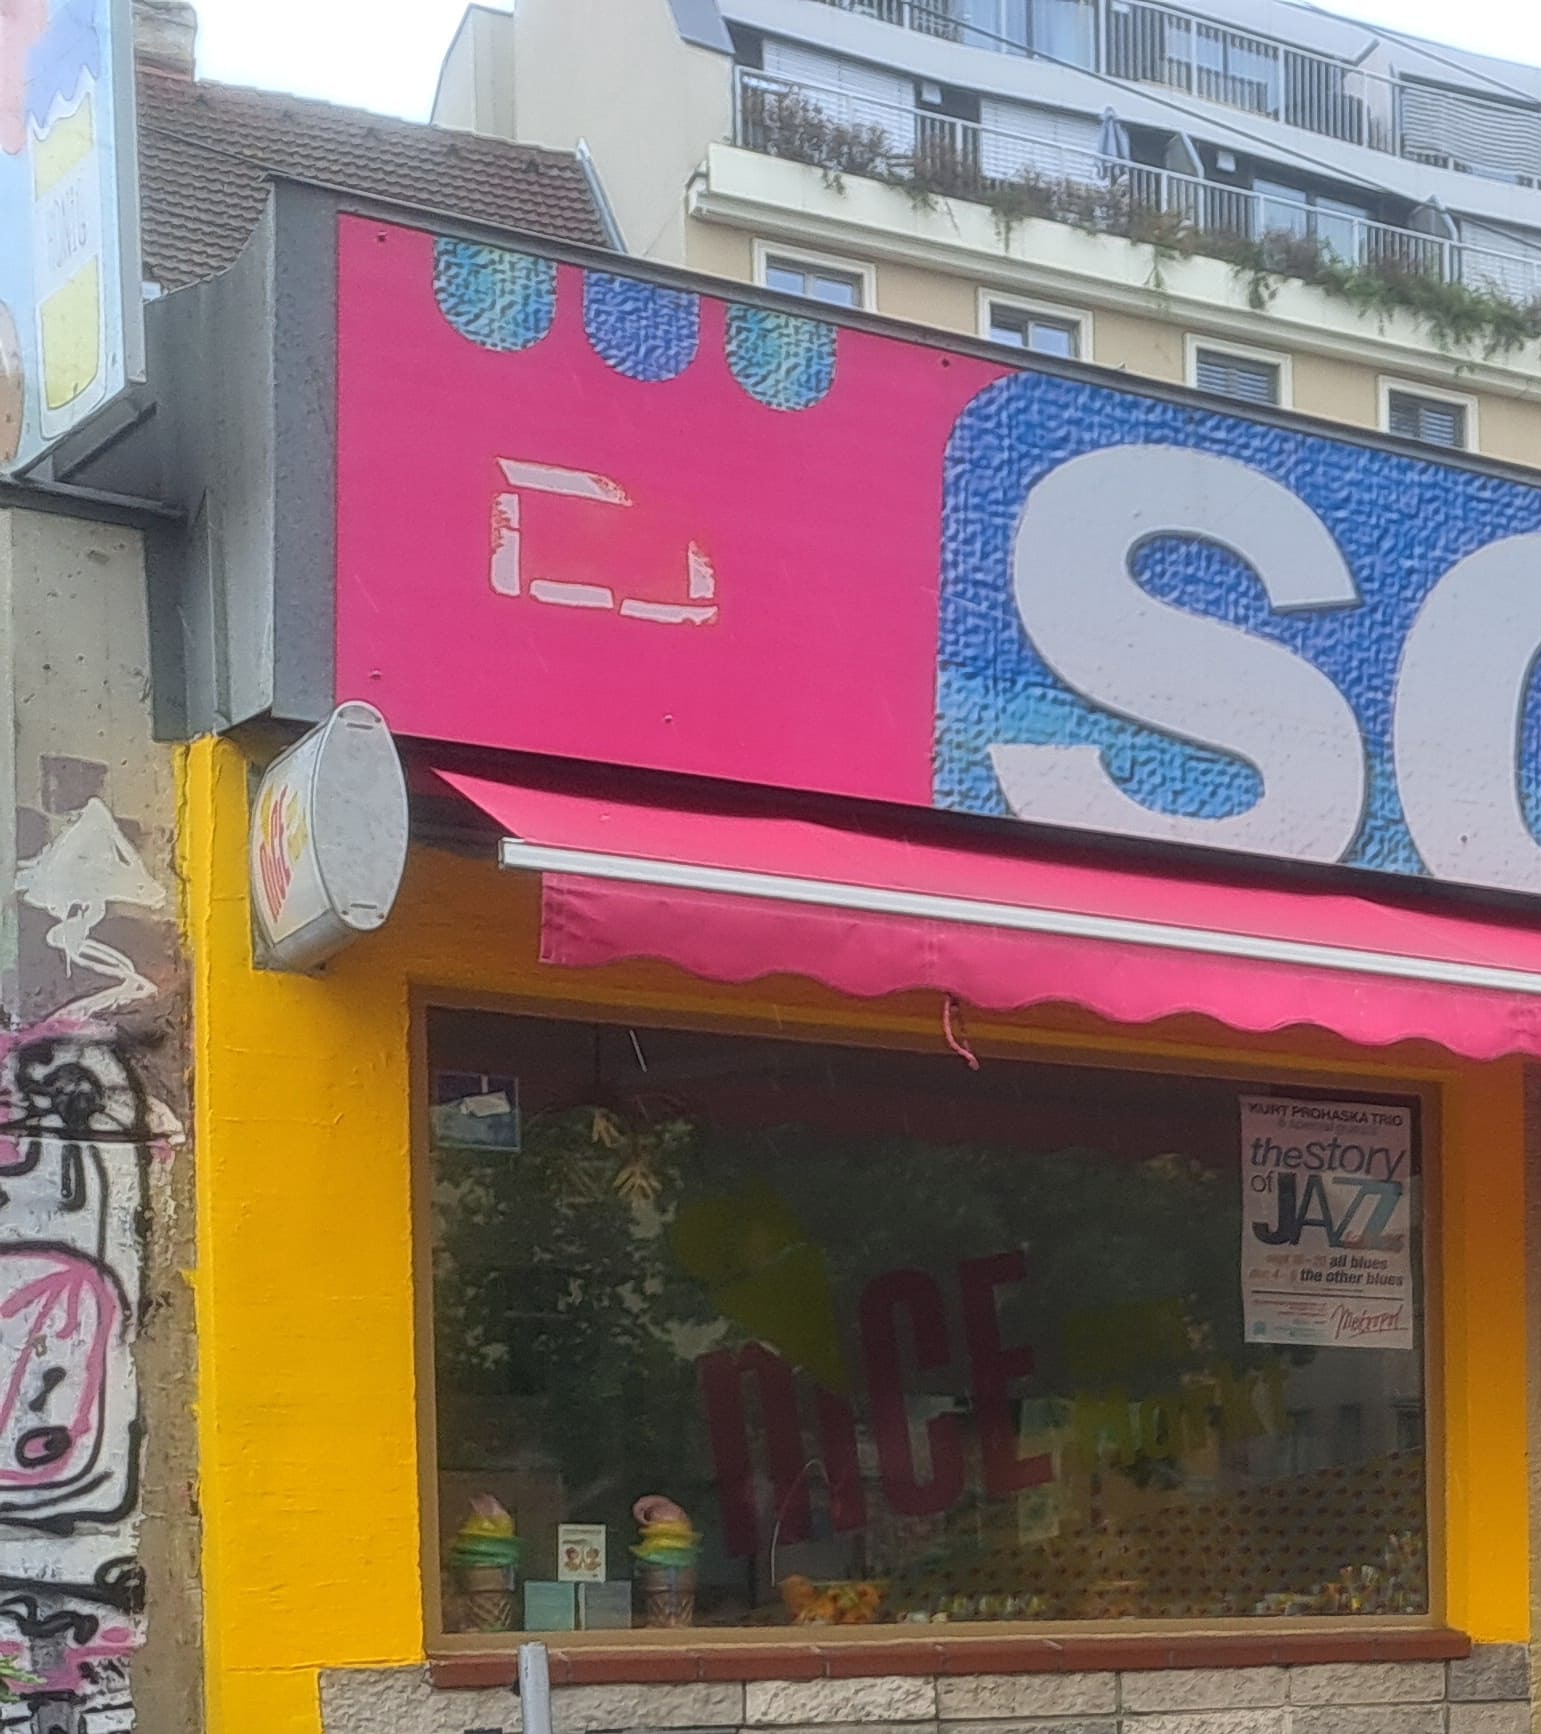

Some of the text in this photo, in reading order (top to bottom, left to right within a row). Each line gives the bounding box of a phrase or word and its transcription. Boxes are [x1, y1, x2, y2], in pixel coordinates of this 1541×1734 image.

[1291, 1104, 1369, 1125] PROHASKA
[1369, 1112, 1403, 1127] TRIO
[1250, 1170, 1273, 1193] of
[1251, 1171, 1404, 1247] JAZZ
[1329, 1253, 1347, 1269] all
[1350, 1255, 1388, 1270] blues
[1300, 1267, 1322, 1283] the
[1325, 1269, 1363, 1285] other
[1366, 1271, 1404, 1287] blues
